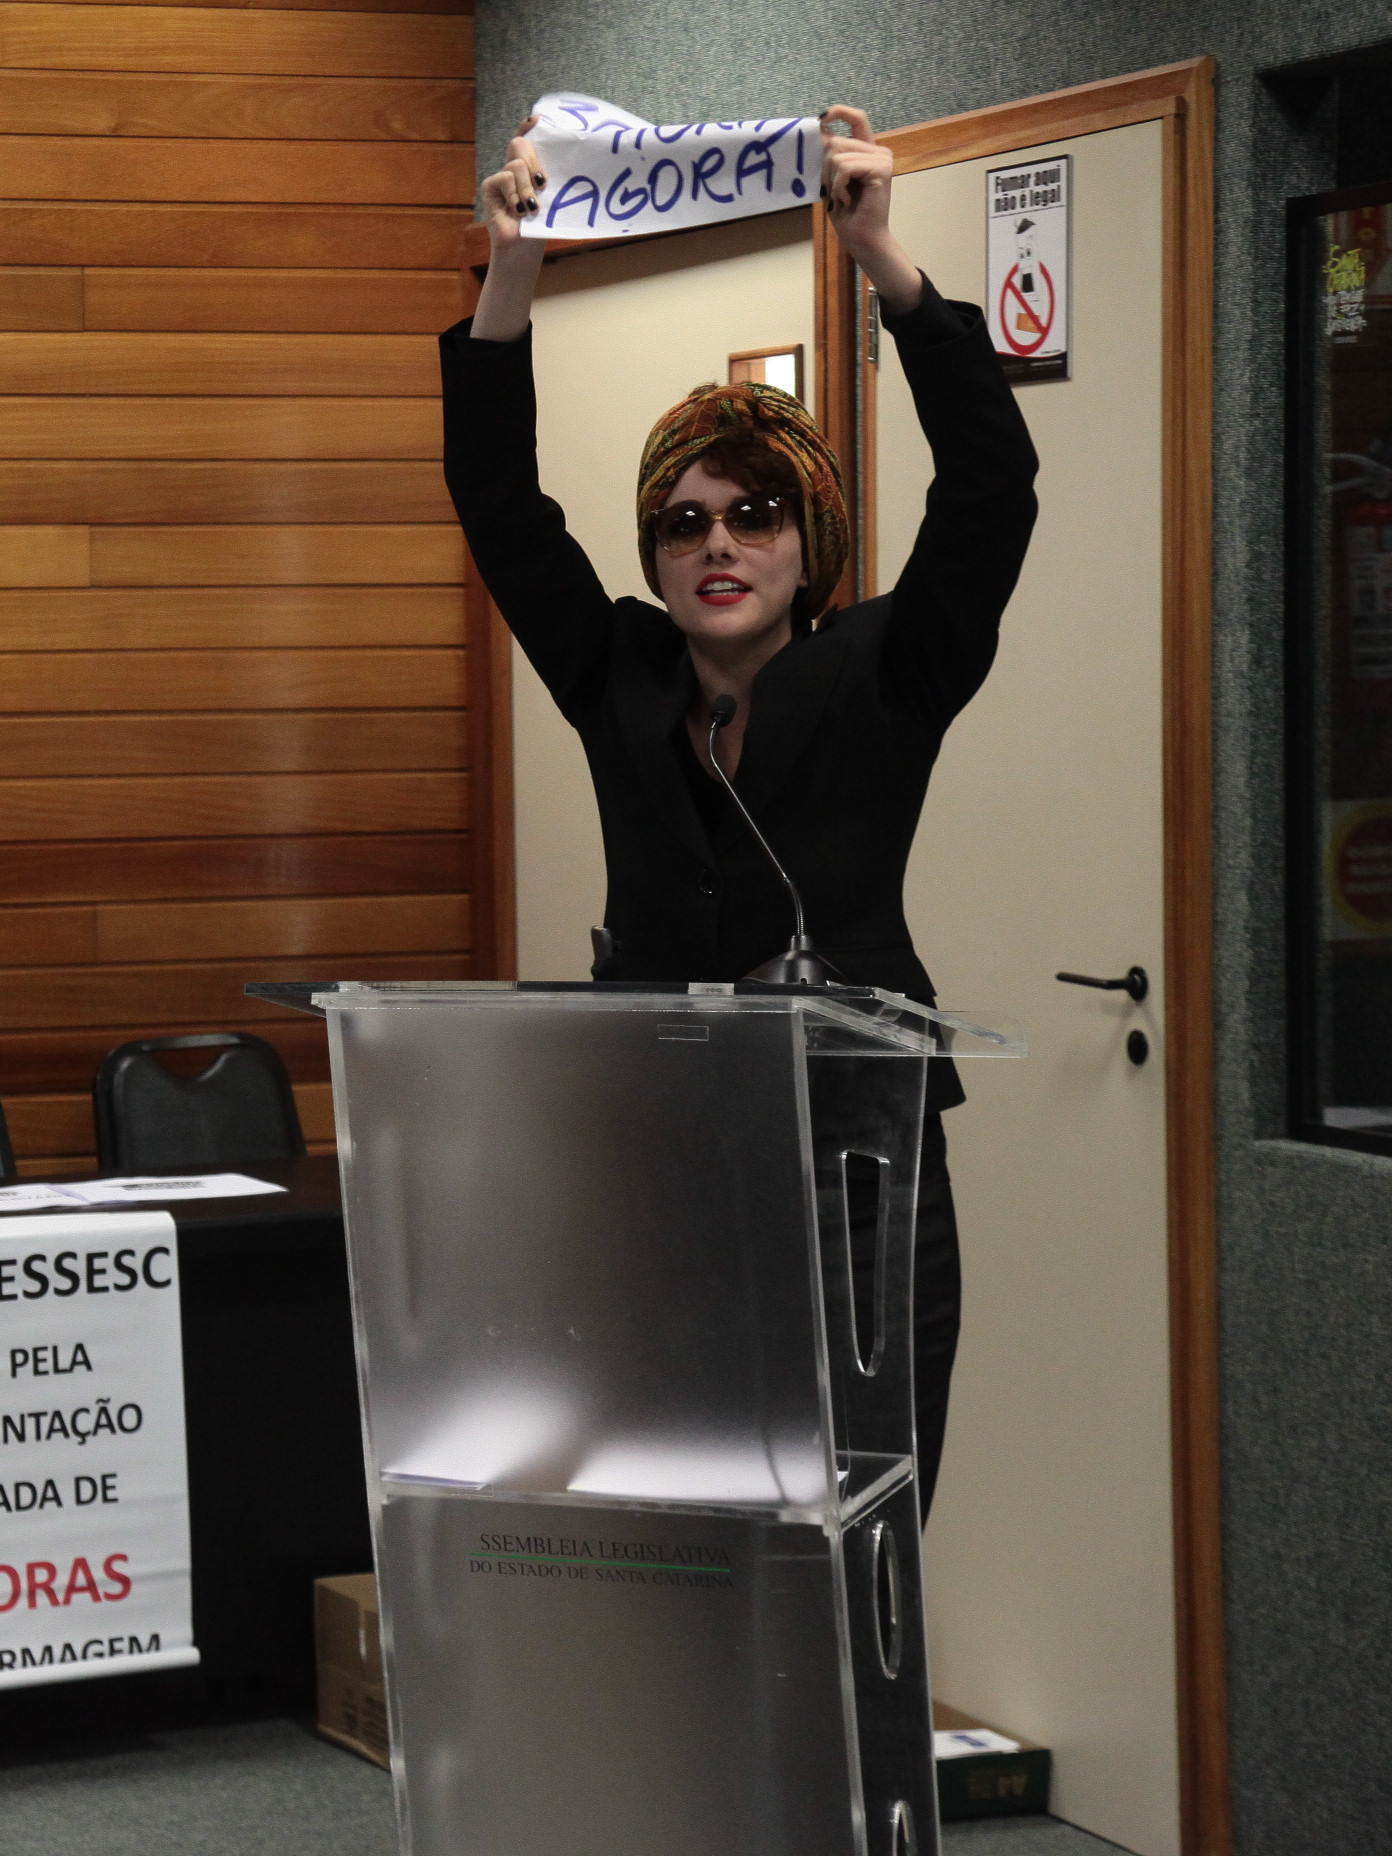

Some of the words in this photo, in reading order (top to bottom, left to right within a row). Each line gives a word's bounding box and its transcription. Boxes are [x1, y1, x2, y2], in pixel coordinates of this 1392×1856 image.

[546, 129, 805, 229] AGORA!
[995, 174, 1030, 193] Fumar
[1034, 165, 1061, 187] aqui
[995, 193, 1016, 213] não
[1020, 190, 1026, 208] é
[1030, 185, 1061, 207] legal
[10, 1343, 93, 1379] PELA
[74, 1474, 119, 1505] DE
[599, 1541, 733, 1566] LEGISLATIVA
[469, 1559, 492, 1573] DO
[498, 1560, 562, 1579] ESTADO
[568, 1565, 590, 1580] DE
[595, 1568, 647, 1585] SANTA
